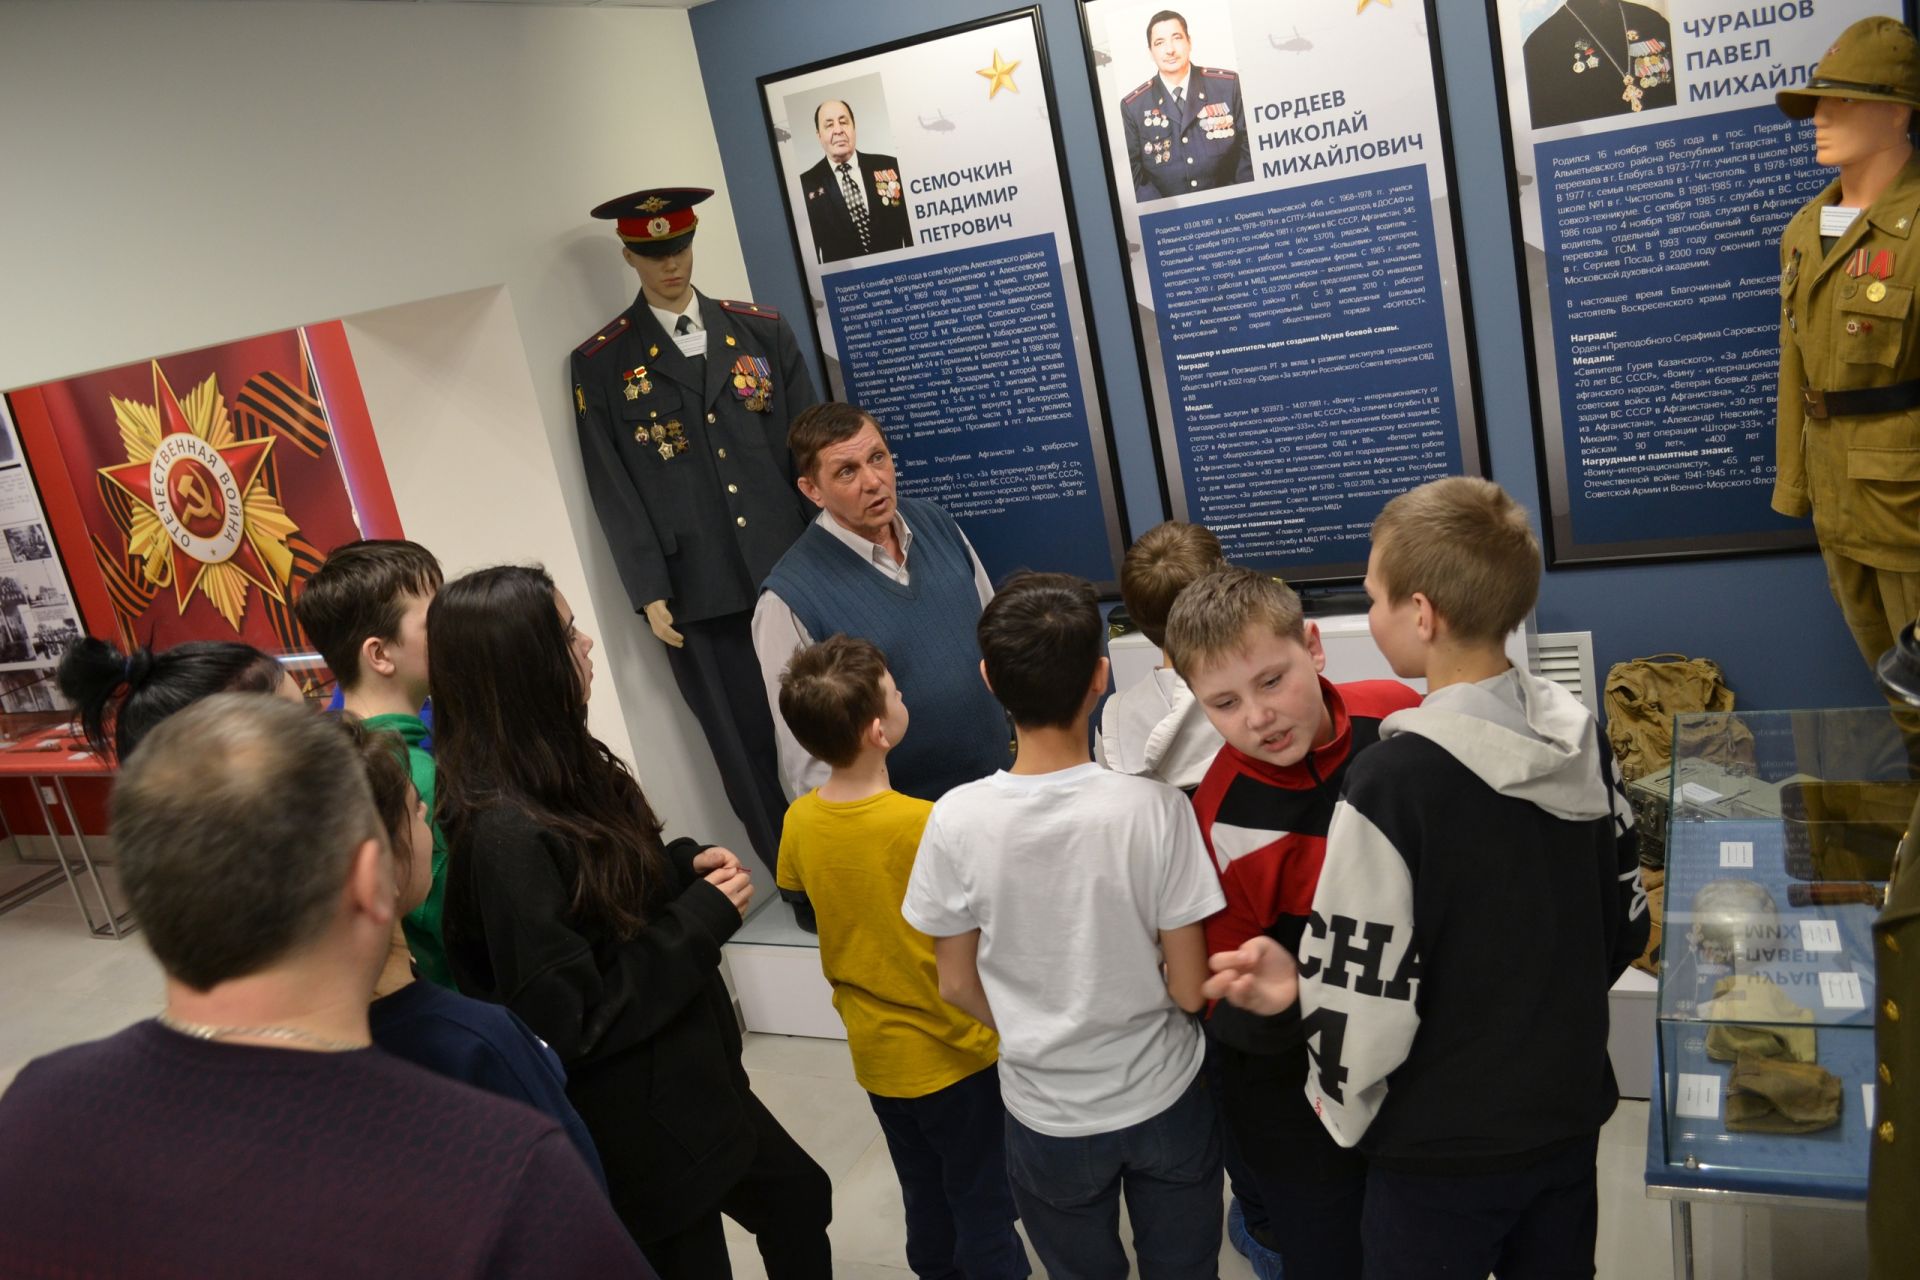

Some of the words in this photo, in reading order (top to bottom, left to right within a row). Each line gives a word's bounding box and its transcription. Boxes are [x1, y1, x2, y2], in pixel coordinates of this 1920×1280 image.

[1683, 0, 1814, 38] ЧУРАШОВ
[1687, 39, 1771, 71] ПАВЕЛ
[1254, 90, 1345, 123] ГОРДЕЕВ
[1258, 110, 1368, 150] НИКОЛАЙ
[1552, 153, 1590, 165] Родился
[1597, 149, 1607, 158] 16
[1614, 144, 1648, 156] ноября
[1655, 138, 1676, 149] 1965
[1683, 135, 1704, 145] года
[1753, 119, 1794, 134] Первый
[1262, 133, 1423, 179] МИХАЙЛОВИЧ
[1553, 161, 1625, 178] Альметьевского
[1629, 155, 1664, 168] района
[1668, 145, 1724, 160] Республики
[910, 160, 1012, 194] СЕМОЧКИН
[915, 185, 1018, 220] ВЛАДИМИР
[1654, 199, 1692, 212] октября
[1695, 195, 1716, 206] 1985
[1729, 188, 1765, 202] служба
[1777, 184, 1792, 194] ВС
[920, 213, 1012, 244] ПЕТРОВИЧ
[1611, 227, 1660, 242] отдельный
[1667, 216, 1741, 234] автомобильный
[1562, 248, 1608, 261] перевозка
[1658, 237, 1679, 248] 1993
[1686, 235, 1707, 244] году
[1714, 229, 1754, 240] окончил
[1564, 269, 1619, 284] Московской
[1620, 263, 1663, 279] духовной
[1580, 294, 1628, 305] настоящее
[1635, 289, 1663, 300] время
[1670, 279, 1731, 294] Благочинный
[1568, 307, 1616, 319] настоятель
[1620, 298, 1693, 313] Воскресенского
[1698, 294, 1727, 305] храма
[1570, 331, 1617, 342] Награды:
[1571, 344, 1600, 354] Орден
[1673, 331, 1721, 343] Серафима
[1572, 355, 1615, 365] Медали:
[1626, 362, 1653, 372] Гурия
[1575, 388, 1624, 400] афганского
[1713, 375, 1748, 385] боевых
[1576, 400, 1619, 410] советских
[1624, 395, 1650, 405] войск
[1622, 431, 1633, 439] 30
[1653, 427, 1697, 437] операции
[1580, 444, 1617, 454] войскам
[1634, 440, 1646, 449] 90
[1581, 455, 1637, 465] Нагрудные
[1647, 450, 1698, 460] памятные
[1700, 447, 1733, 455] знаки:
[1583, 474, 1649, 487] Отечественной
[1653, 472, 1680, 481] войне
[1684, 468, 1725, 479] 1941-1945
[1584, 486, 1630, 498] Советской
[1631, 486, 1661, 496] Армии
[1670, 480, 1751, 492] Военно-Морского
[154, 439, 218, 547] ОТЕЧЕСТВЕННАЯ
[220, 472, 242, 543] ВОЙНА
